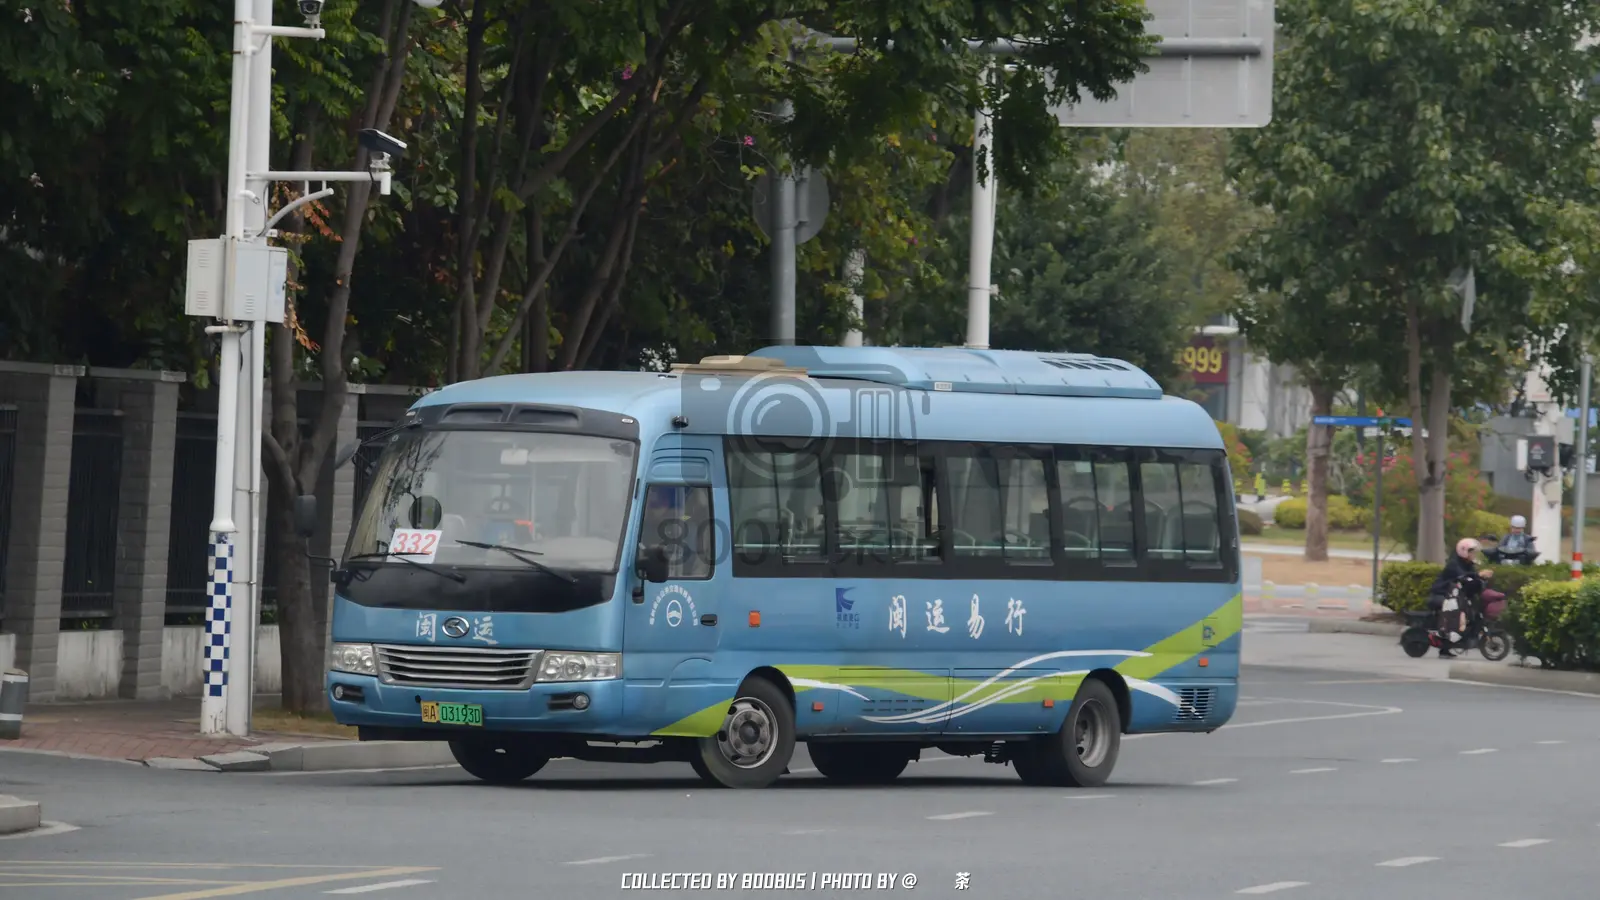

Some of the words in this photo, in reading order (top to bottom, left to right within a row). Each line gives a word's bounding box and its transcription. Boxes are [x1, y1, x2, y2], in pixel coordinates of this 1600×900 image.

[393, 532, 437, 555] 332
[888, 592, 1027, 640] 闽运易行
